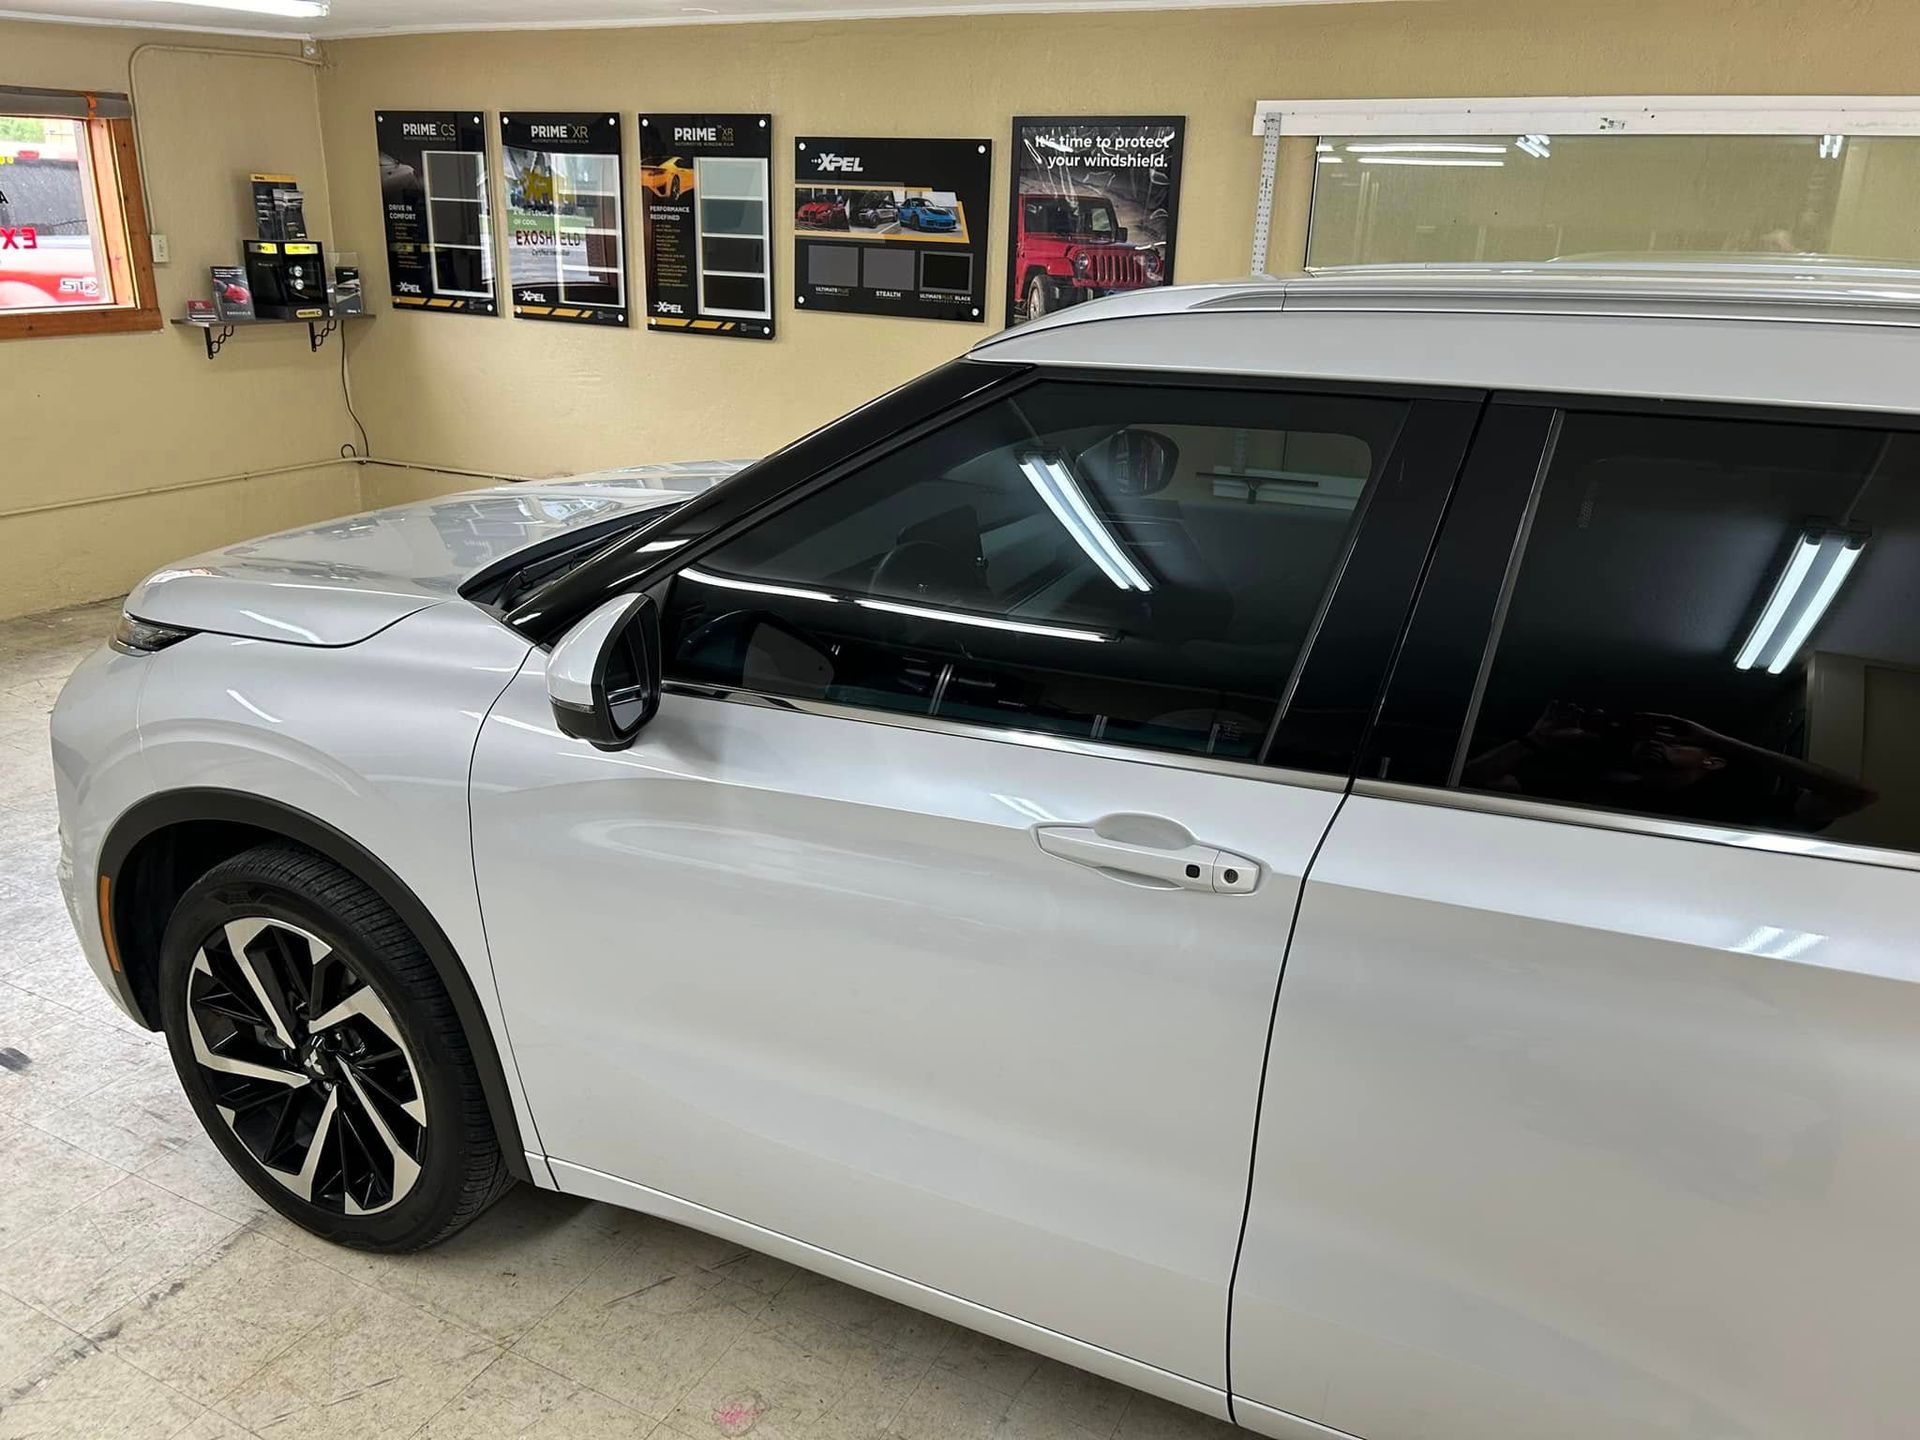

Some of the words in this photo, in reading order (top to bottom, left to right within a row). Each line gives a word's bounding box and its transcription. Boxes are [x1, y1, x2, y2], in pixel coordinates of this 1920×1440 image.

[402, 123, 437, 136] PRIME
[440, 123, 456, 136] CS
[530, 125, 568, 138] PRIME
[571, 126, 588, 138] XR
[674, 127, 717, 141] PRIME
[1060, 134, 1092, 147] time
[1096, 136, 1111, 147] to
[1115, 136, 1169, 150] protect
[817, 153, 863, 171] XPEL
[1047, 156, 1080, 169] your
[1084, 153, 1168, 167] windshield.
[516, 230, 580, 246] EXOSHIELD
[400, 282, 421, 293] XPEL
[523, 291, 546, 302] XPEL
[658, 301, 683, 313] XPEL
